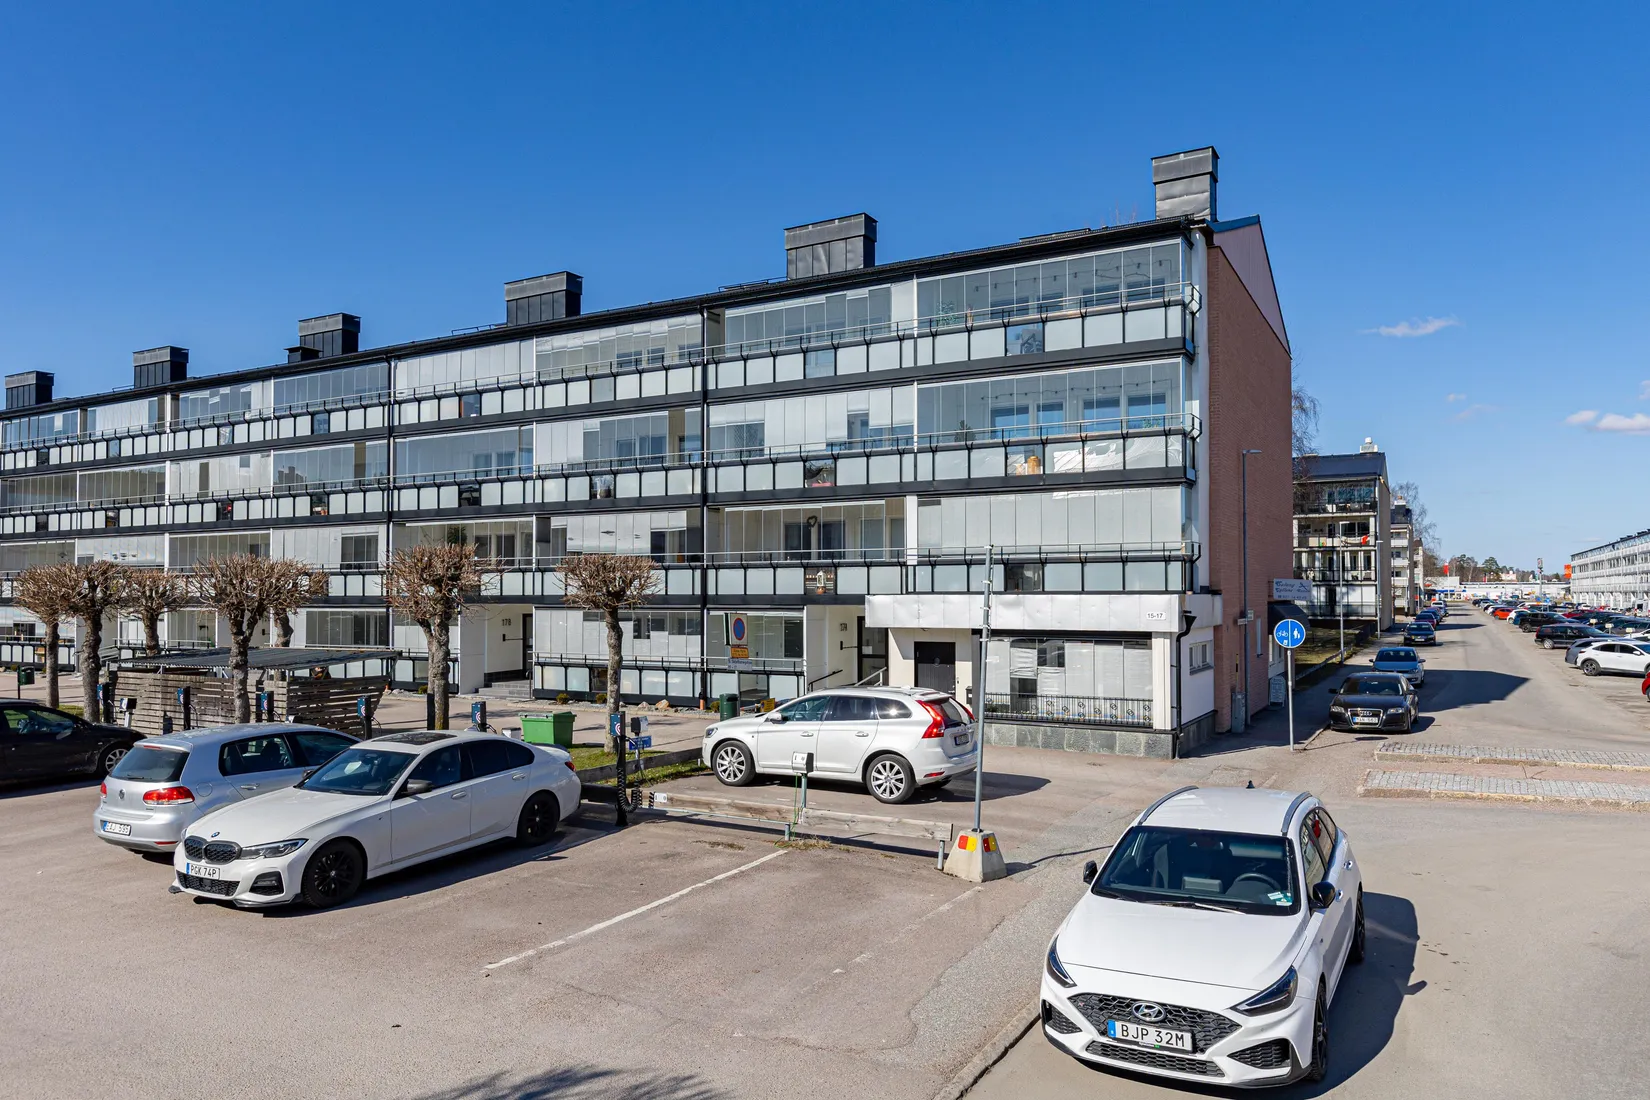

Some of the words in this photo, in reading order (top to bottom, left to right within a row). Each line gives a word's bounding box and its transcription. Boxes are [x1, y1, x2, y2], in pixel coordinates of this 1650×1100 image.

[190, 864, 202, 876] PGK
[203, 867, 217, 878] 74P
[1121, 1024, 1149, 1041] BJP
[1154, 1029, 1185, 1048] 32M
